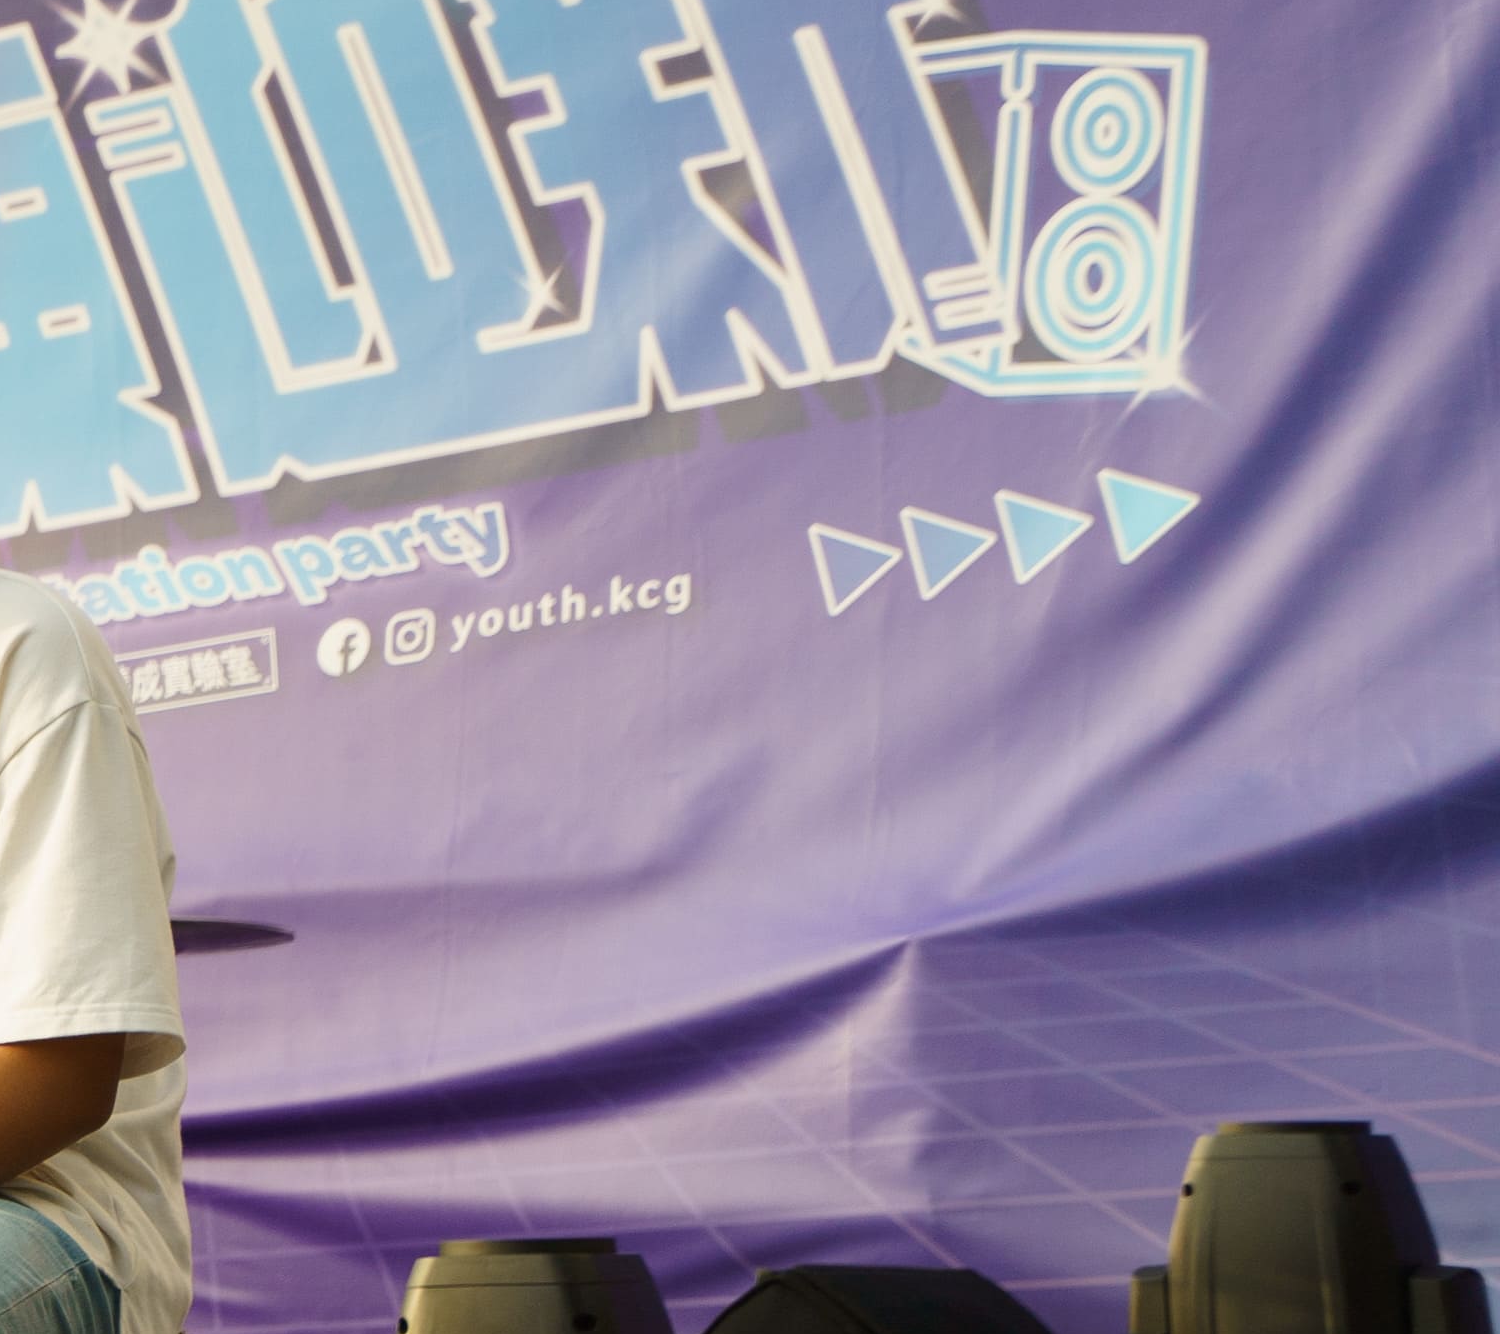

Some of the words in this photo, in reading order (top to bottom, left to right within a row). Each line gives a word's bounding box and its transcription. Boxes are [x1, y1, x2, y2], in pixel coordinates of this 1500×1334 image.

[272, 502, 508, 605] party
[450, 573, 691, 653] youth.kcg
[119, 646, 263, 703] 成實驗室
